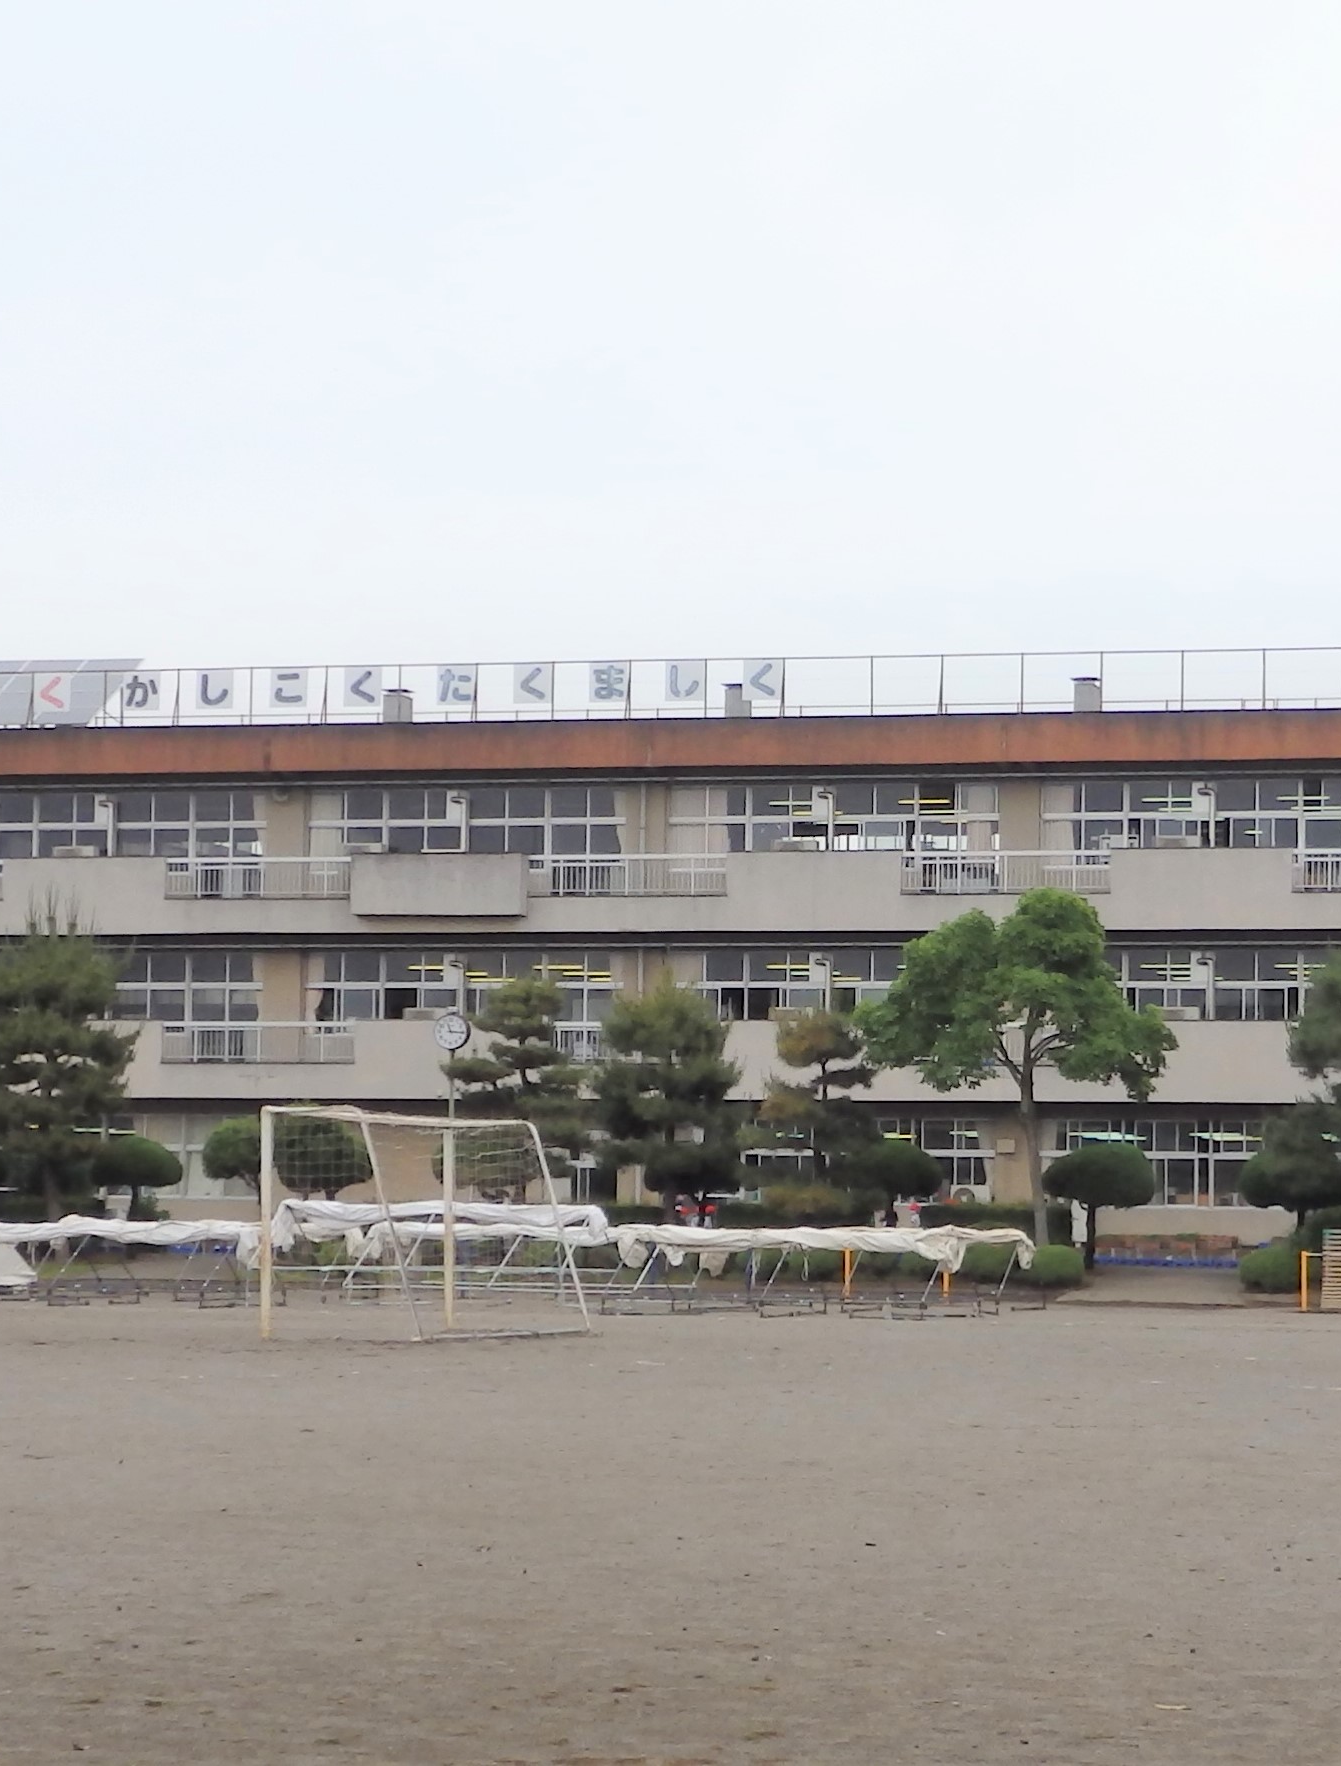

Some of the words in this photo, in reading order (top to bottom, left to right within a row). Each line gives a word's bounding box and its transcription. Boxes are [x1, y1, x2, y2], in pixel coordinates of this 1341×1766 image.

[125, 670, 376, 708] かしこく
[439, 663, 775, 702] たくましく
